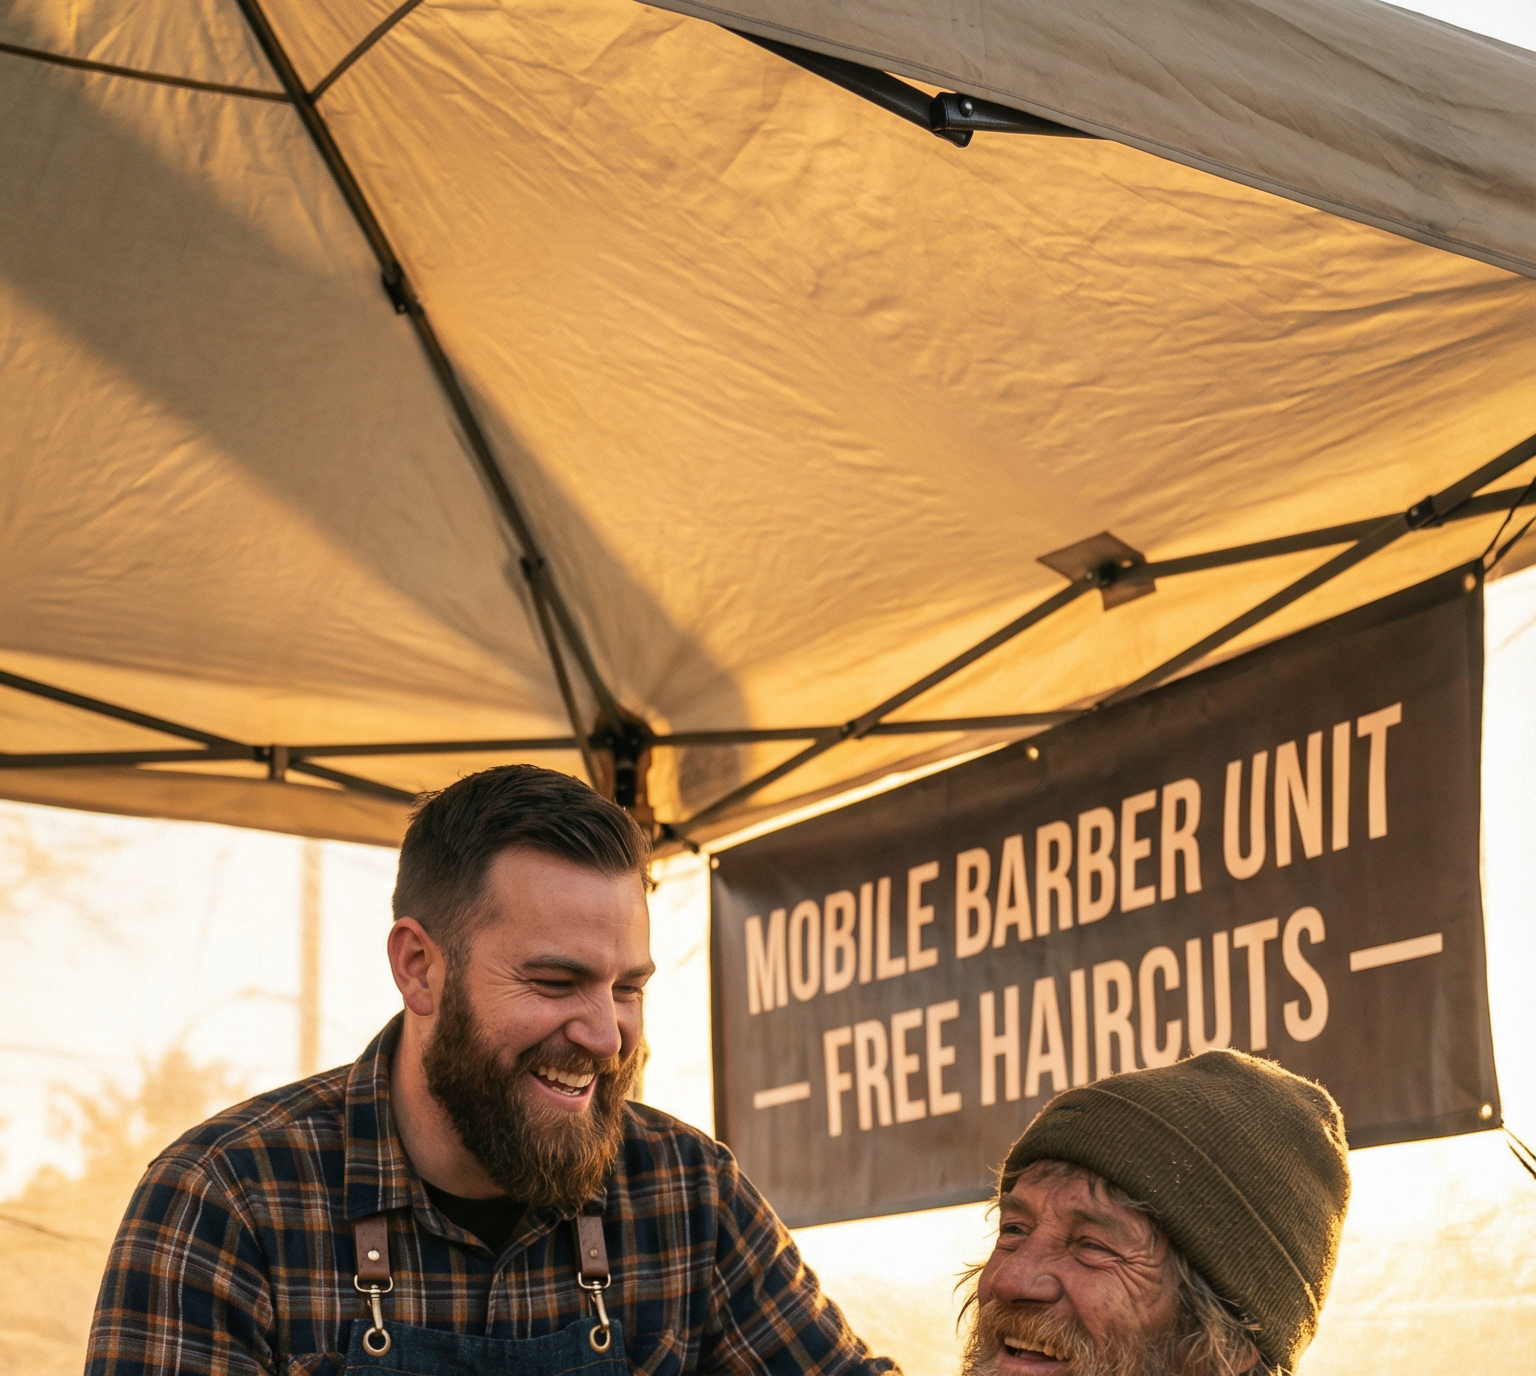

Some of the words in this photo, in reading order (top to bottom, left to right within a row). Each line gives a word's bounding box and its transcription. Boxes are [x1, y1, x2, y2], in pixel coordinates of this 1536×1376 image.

[744, 861, 940, 1016] MOBILE
[955, 777, 1202, 959] BARBER
[1222, 702, 1402, 881] UNIT
[822, 1000, 962, 1138] FREE
[979, 906, 1329, 1106] HAIRCUTS
